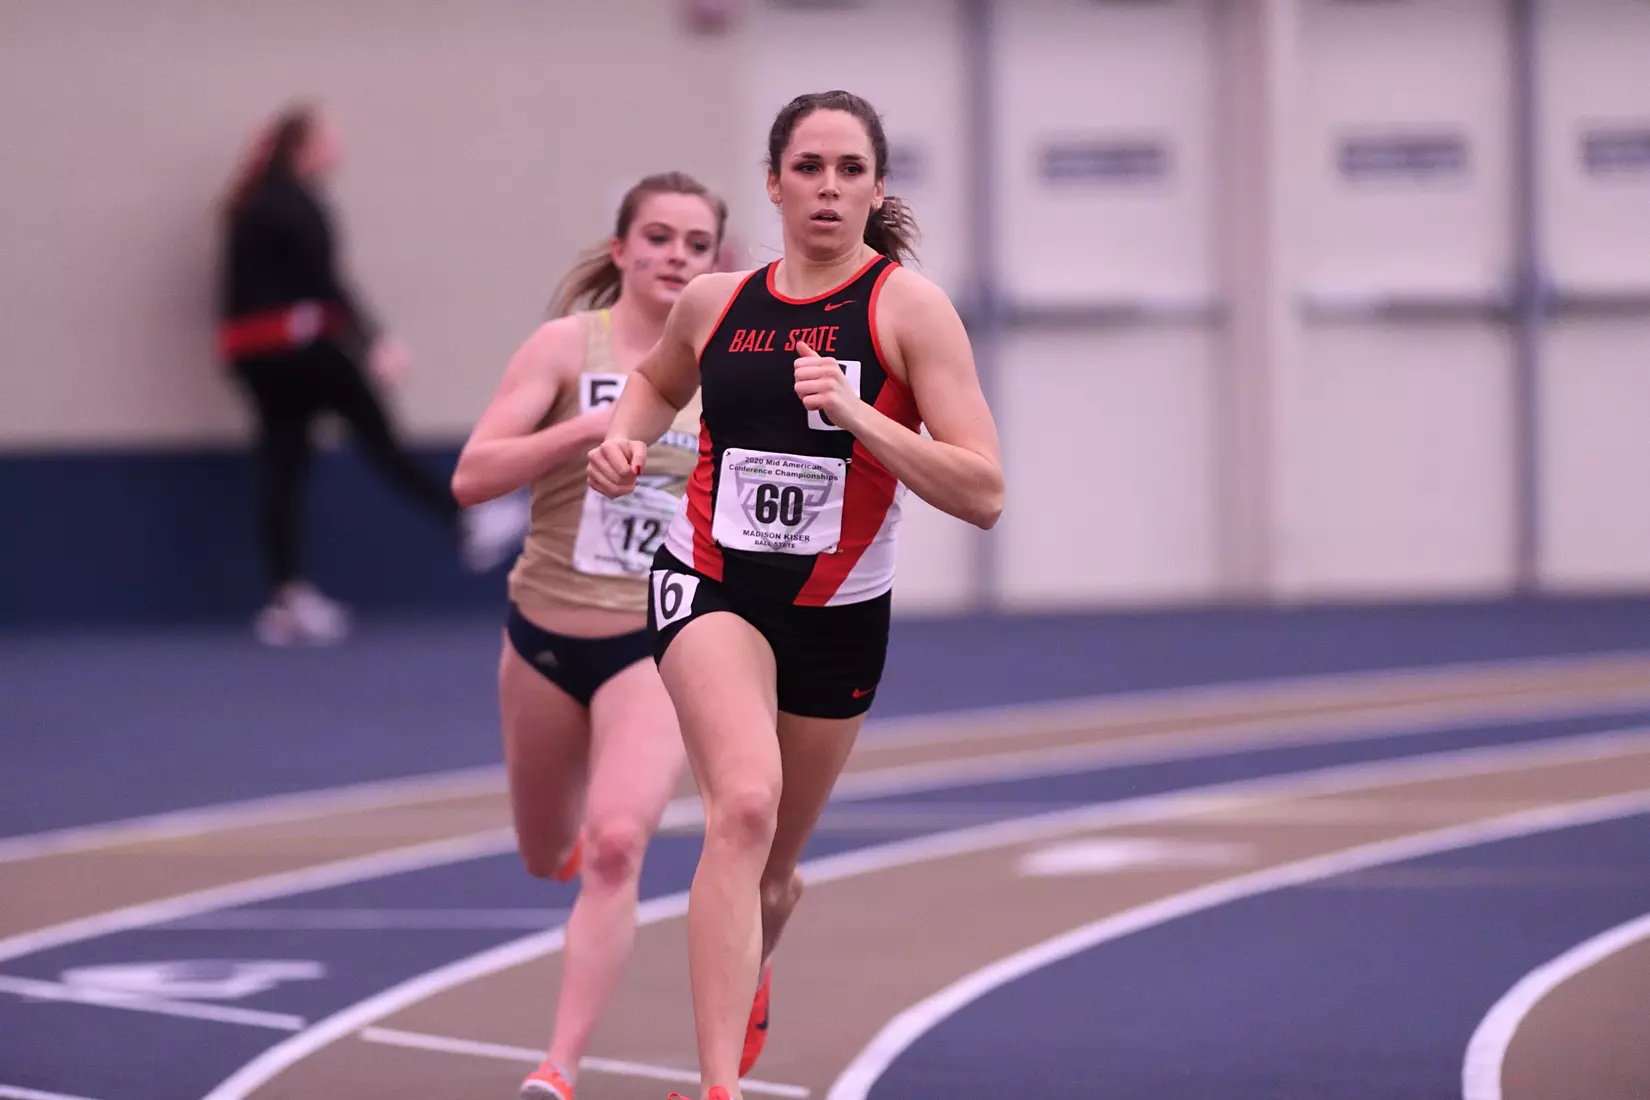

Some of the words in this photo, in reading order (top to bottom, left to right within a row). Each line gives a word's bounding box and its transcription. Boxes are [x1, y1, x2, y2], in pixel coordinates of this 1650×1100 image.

[728, 329, 776, 352] BALL
[784, 326, 840, 352] STATE
[728, 464, 773, 476] Conference
[775, 469, 839, 481] Championships
[745, 456, 764, 465] 2020
[766, 459, 780, 467] Mid
[782, 460, 822, 471] American
[755, 483, 804, 527] 60
[622, 515, 660, 557] 12
[742, 529, 781, 540] MADISON
[783, 532, 811, 542] KISER
[754, 539, 772, 548] BALL
[774, 541, 796, 549] STATE
[660, 570, 684, 620] 6
